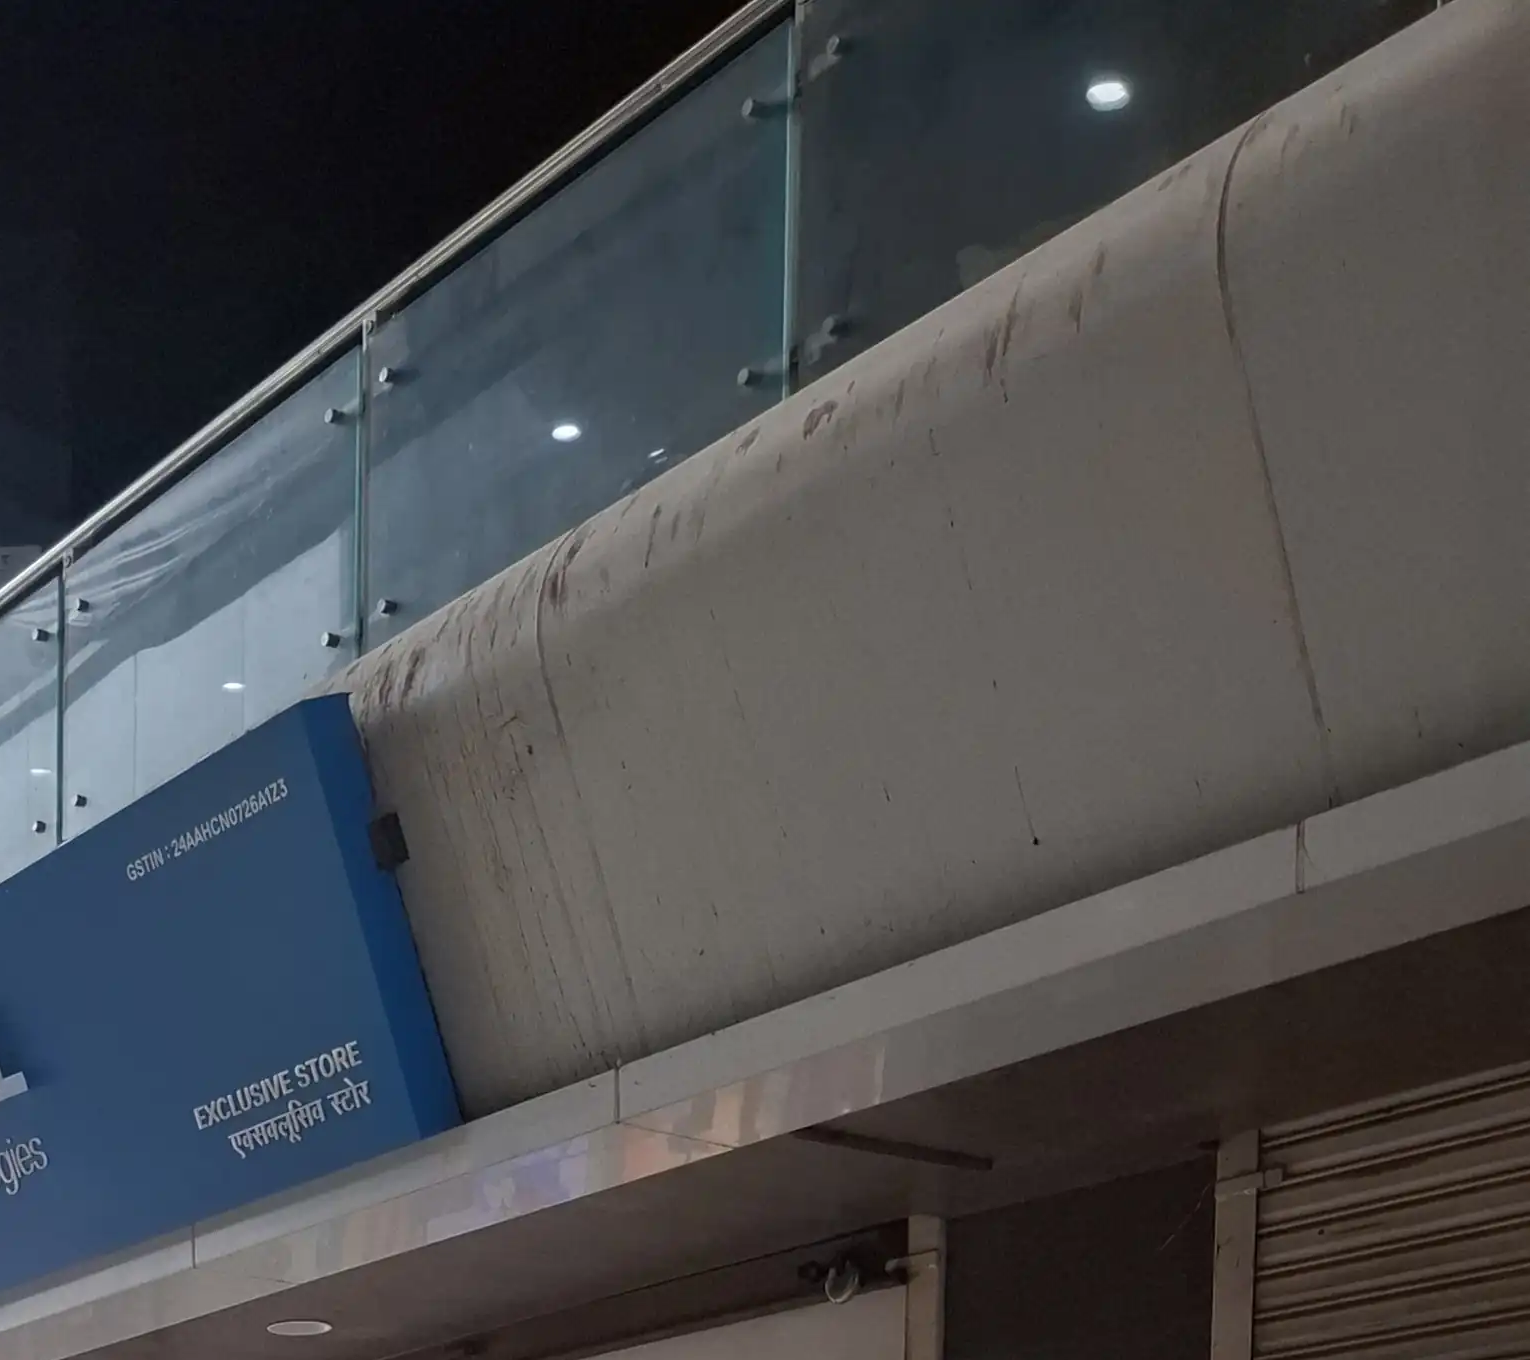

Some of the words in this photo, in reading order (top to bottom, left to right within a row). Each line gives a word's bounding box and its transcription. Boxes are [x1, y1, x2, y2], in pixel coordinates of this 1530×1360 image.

[126, 847, 165, 881] GSTIN
[171, 778, 288, 857] 24AAHCN0726A1Z3
[193, 1070, 294, 1130] EXCLUSIVE
[295, 1041, 362, 1087] STORE
